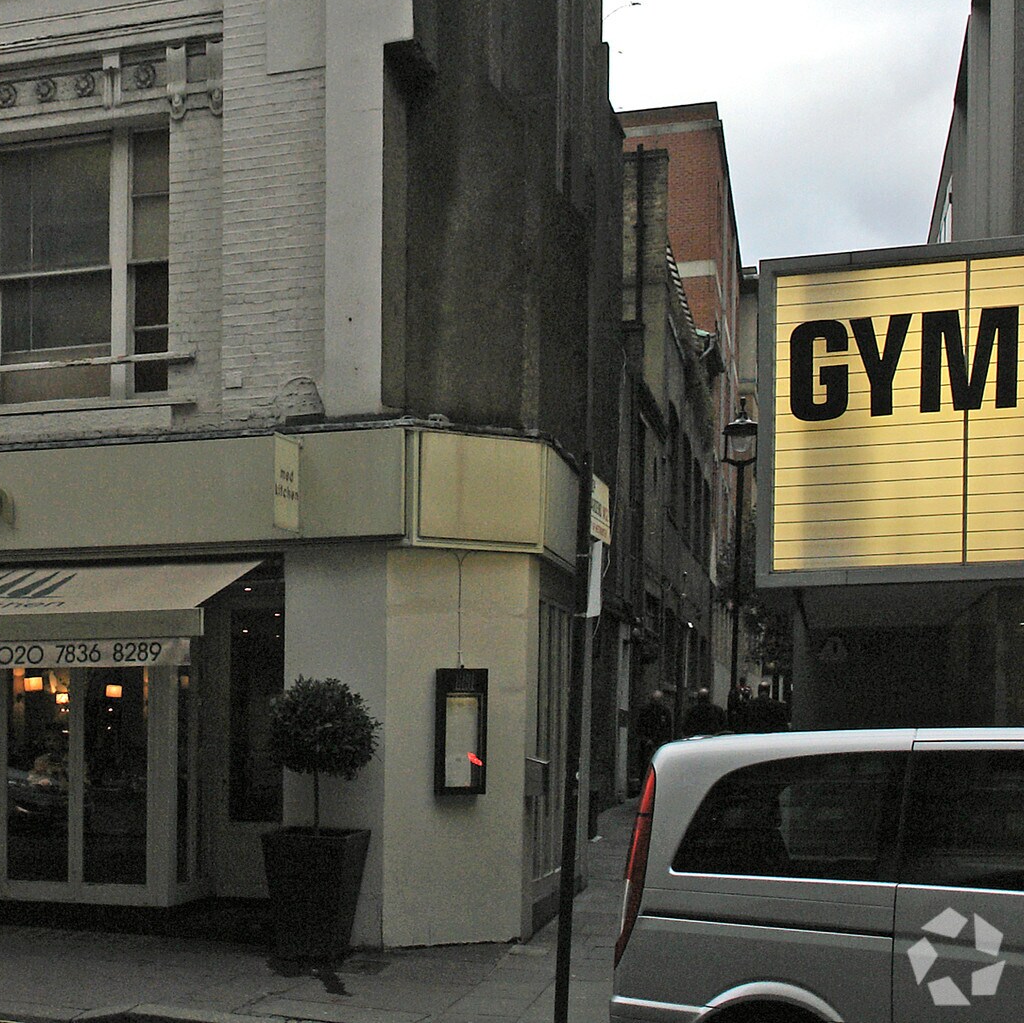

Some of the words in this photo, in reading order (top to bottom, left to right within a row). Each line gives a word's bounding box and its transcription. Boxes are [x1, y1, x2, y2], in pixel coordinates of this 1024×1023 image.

[789, 305, 1019, 422] GYM
[55, 643, 101, 664] 7836
[112, 641, 162, 663] 8289
